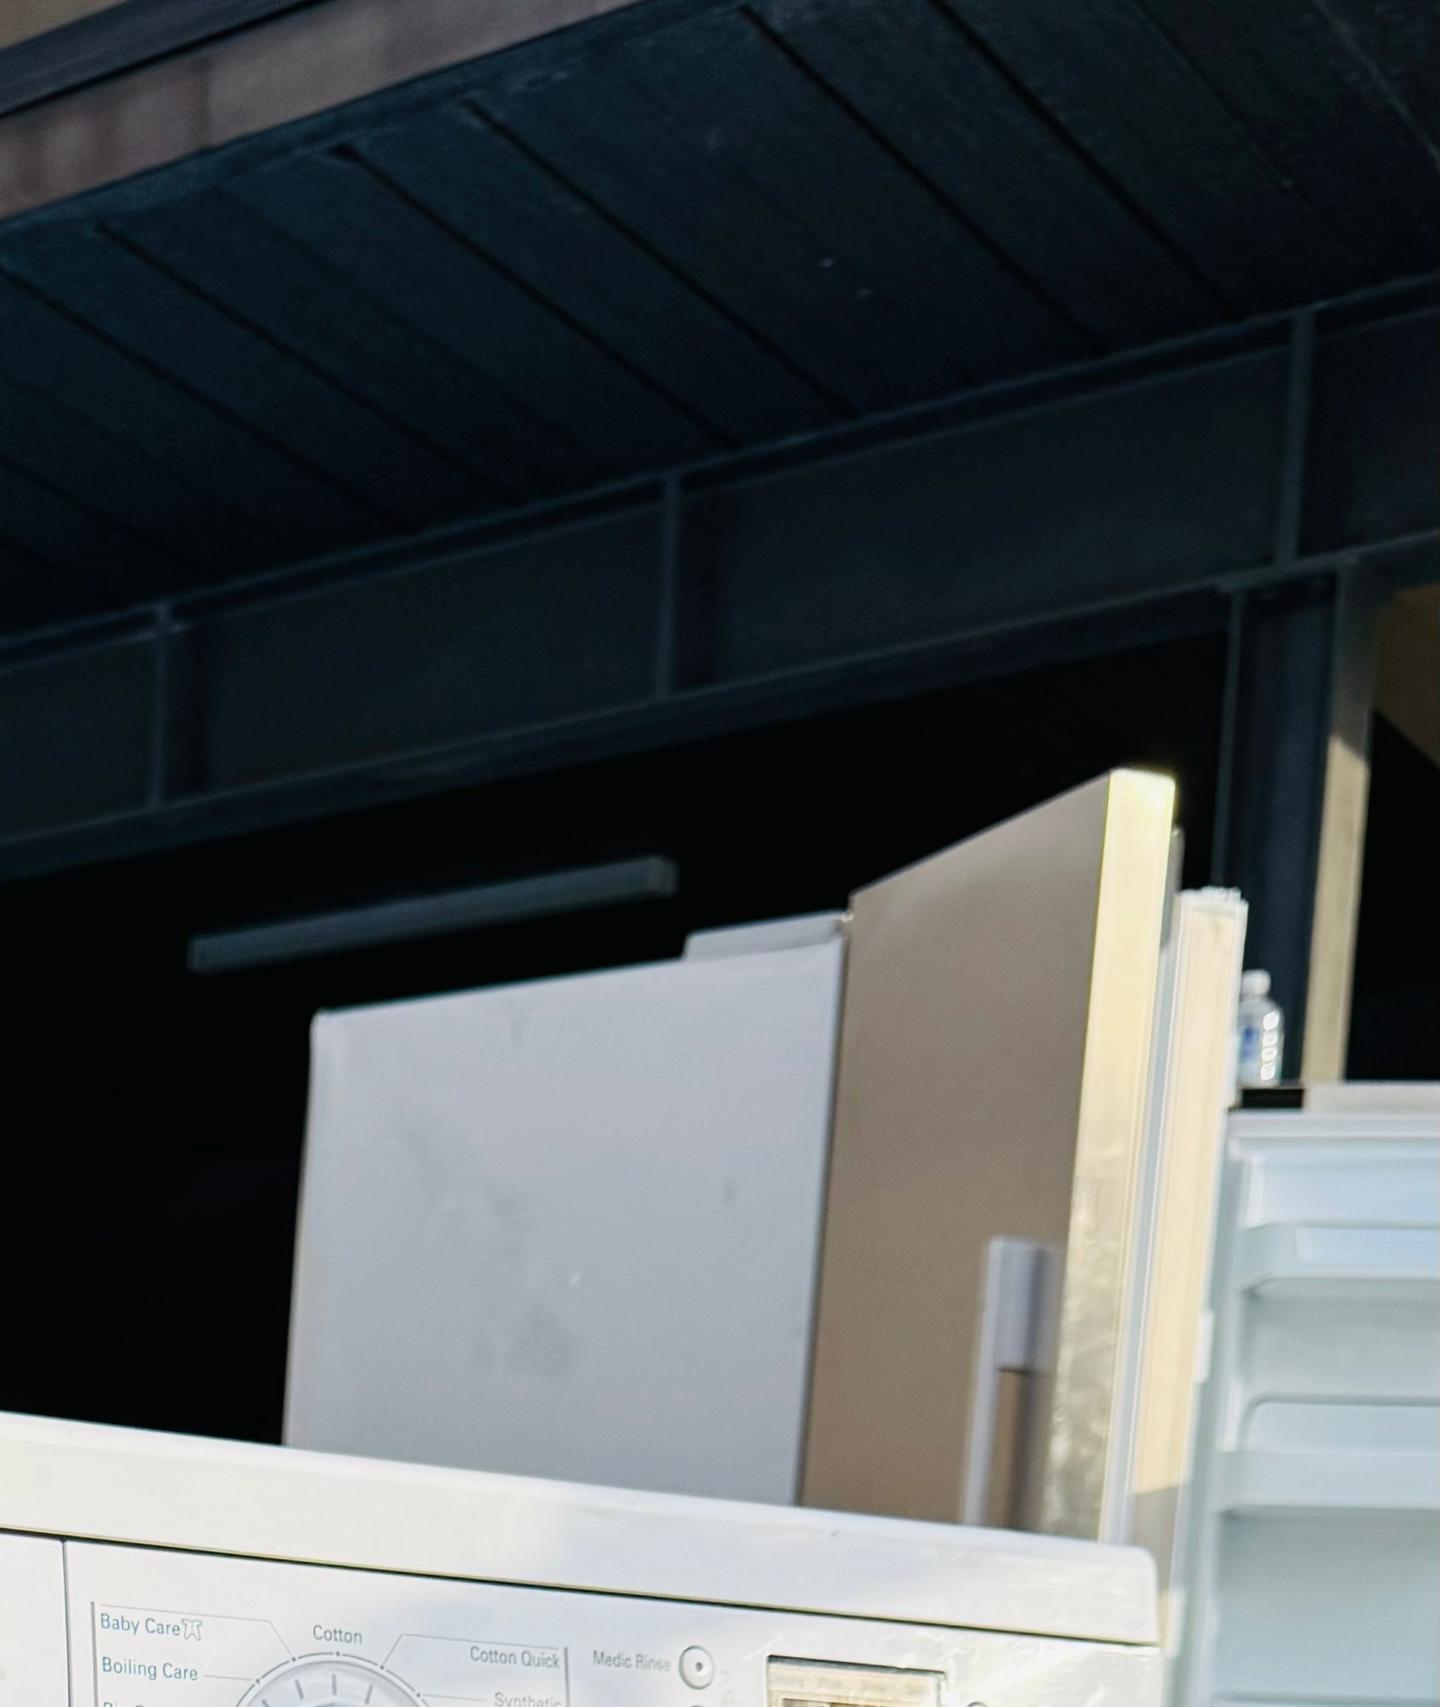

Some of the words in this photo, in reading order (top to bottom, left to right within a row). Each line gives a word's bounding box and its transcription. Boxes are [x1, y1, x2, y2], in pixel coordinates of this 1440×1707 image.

[100, 1613, 140, 1635] Baby
[145, 1618, 181, 1636] Care
[313, 1625, 363, 1644] Cotton
[102, 1656, 157, 1681] Boiling
[162, 1663, 198, 1681] Care
[470, 1646, 517, 1665] Cotton
[521, 1651, 560, 1669] Quick
[593, 1650, 632, 1669] Medic
[635, 1654, 671, 1671] Rinse
